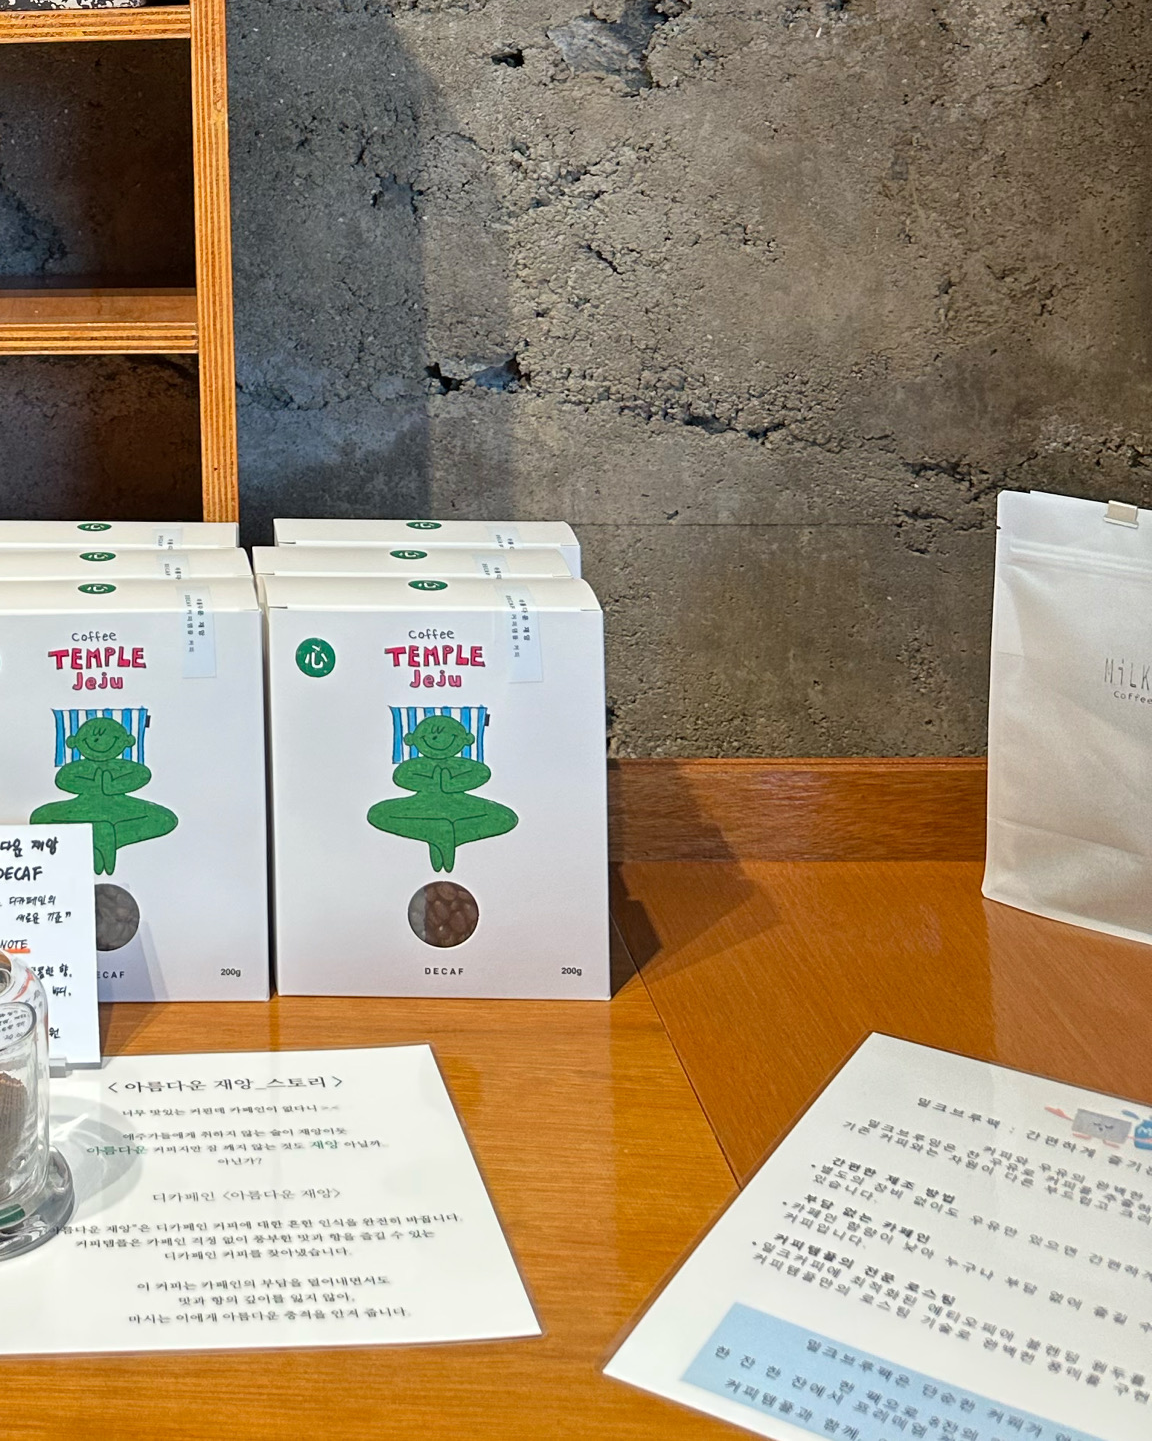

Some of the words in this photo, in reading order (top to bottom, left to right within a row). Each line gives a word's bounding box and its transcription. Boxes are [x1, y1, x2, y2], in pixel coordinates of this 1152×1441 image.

[48, 646, 146, 670] TEMPLE
[384, 644, 485, 667] TEMPLE
[72, 669, 123, 691] Jeju
[409, 670, 462, 688] Jeju
[31, 837, 58, 855] 재앙
[9, 895, 56, 906] 디카페인의
[0, 939, 29, 949] NOTE
[97, 971, 124, 981] ECAF
[221, 968, 241, 977] 200g
[562, 967, 582, 976] 200g
[124, 1079, 207, 1094] 아름다운
[1026, 1130, 1097, 1159] 간편하게
[832, 1157, 877, 1178] 간편한
[885, 1174, 915, 1190] 제조
[925, 1187, 956, 1205] 방법
[152, 1190, 216, 1204] 디카페인
[222, 1189, 295, 1201] <아름다운
[301, 1187, 341, 1199] 재앙>
[804, 1193, 834, 1211] 부담
[842, 1206, 872, 1224] 없는
[882, 1221, 931, 1245] 카페인
